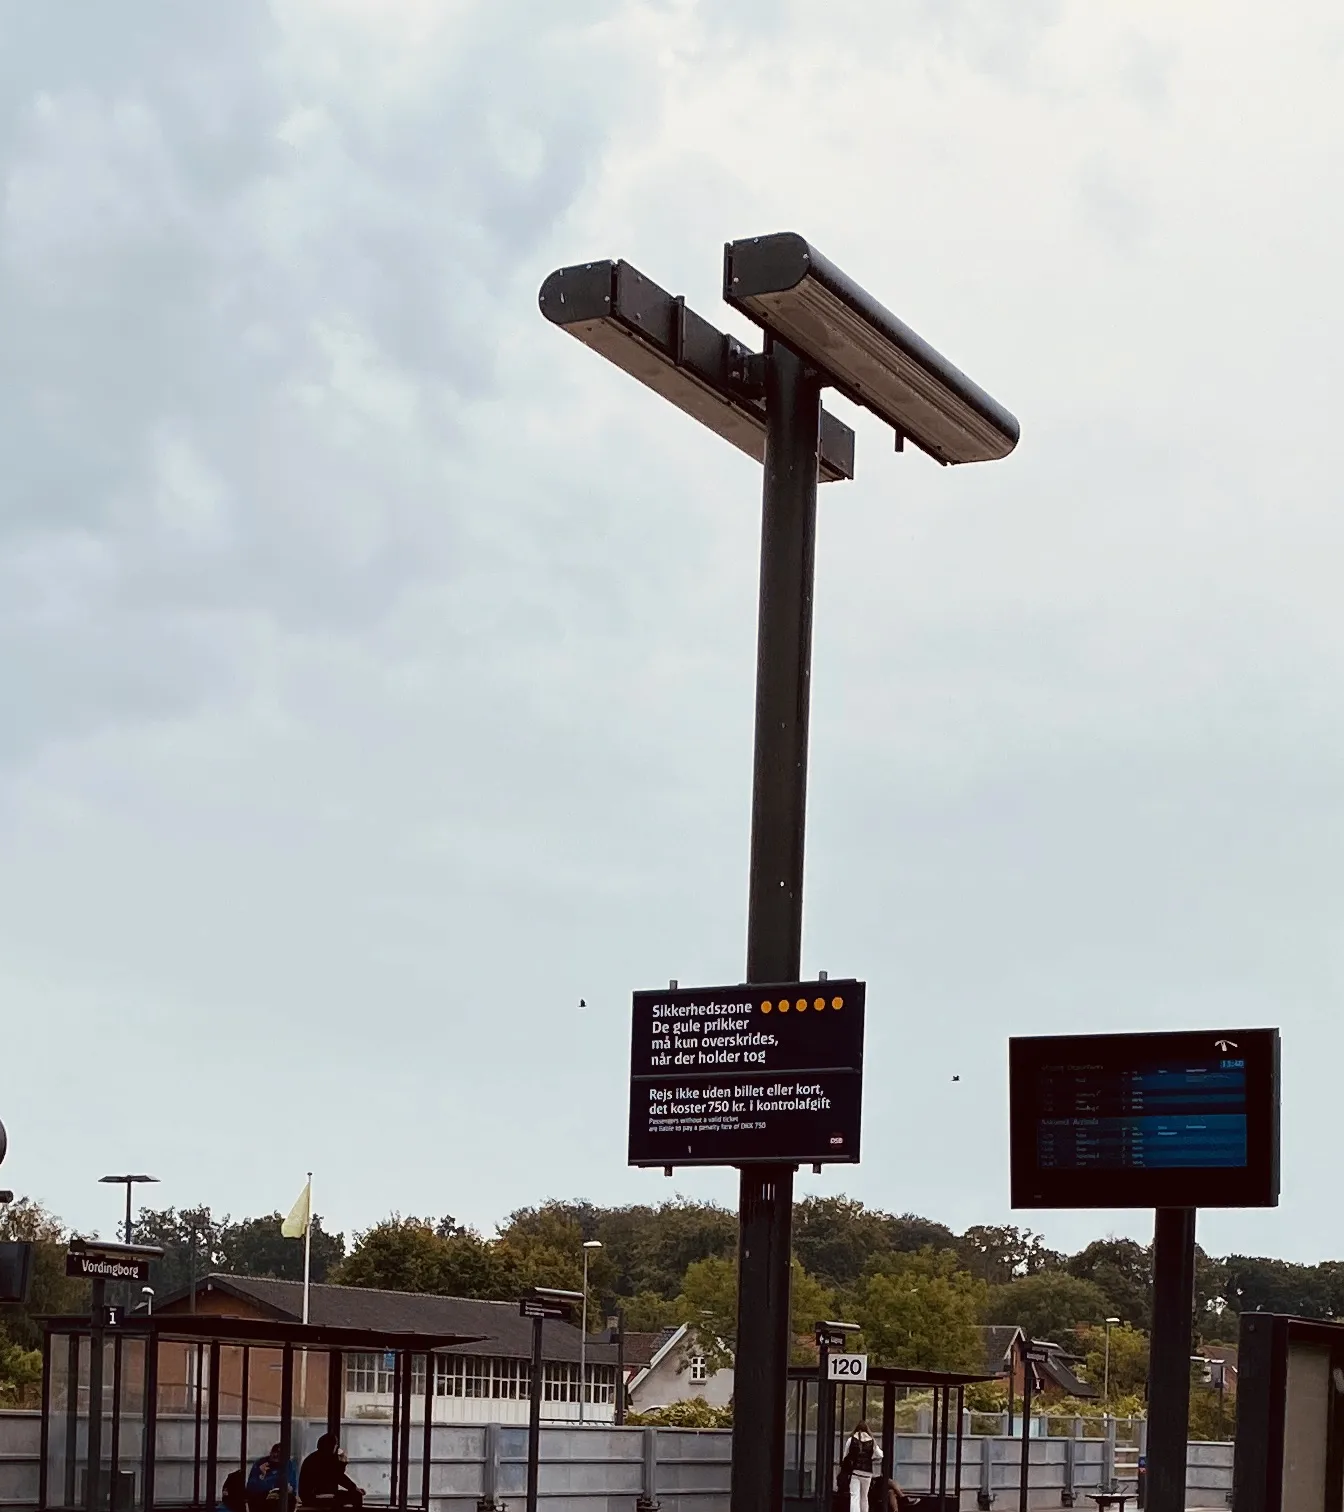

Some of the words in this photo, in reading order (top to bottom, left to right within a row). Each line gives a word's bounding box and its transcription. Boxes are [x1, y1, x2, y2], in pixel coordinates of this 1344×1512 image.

[652, 1002, 753, 1018] Sikkerhedszone
[652, 1021, 669, 1034] De
[673, 1019, 701, 1035] gule
[704, 1018, 749, 1034] prikker
[651, 1035, 671, 1049] må
[674, 1036, 698, 1049] kun
[701, 1032, 779, 1047] overskrides,
[651, 1052, 672, 1065] når
[674, 1052, 696, 1065] der
[698, 1050, 740, 1064] holder
[743, 1050, 766, 1063] tog
[649, 1088, 673, 1103] Rejs
[675, 1087, 699, 1100] ikke
[702, 1086, 731, 1099] uden
[734, 1084, 764, 1098] billet
[766, 1084, 793, 1097] eller
[795, 1083, 824, 1096] kort,
[649, 1103, 667, 1115] det
[670, 1102, 706, 1114] koster
[707, 1101, 730, 1113] 750
[732, 1100, 746, 1112] kr.
[749, 1100, 754, 1111] i
[756, 1097, 831, 1111] kontrolafgift
[81, 1259, 139, 1279] Vordingborg
[109, 1312, 117, 1325] 1
[831, 1358, 862, 1375] 120
